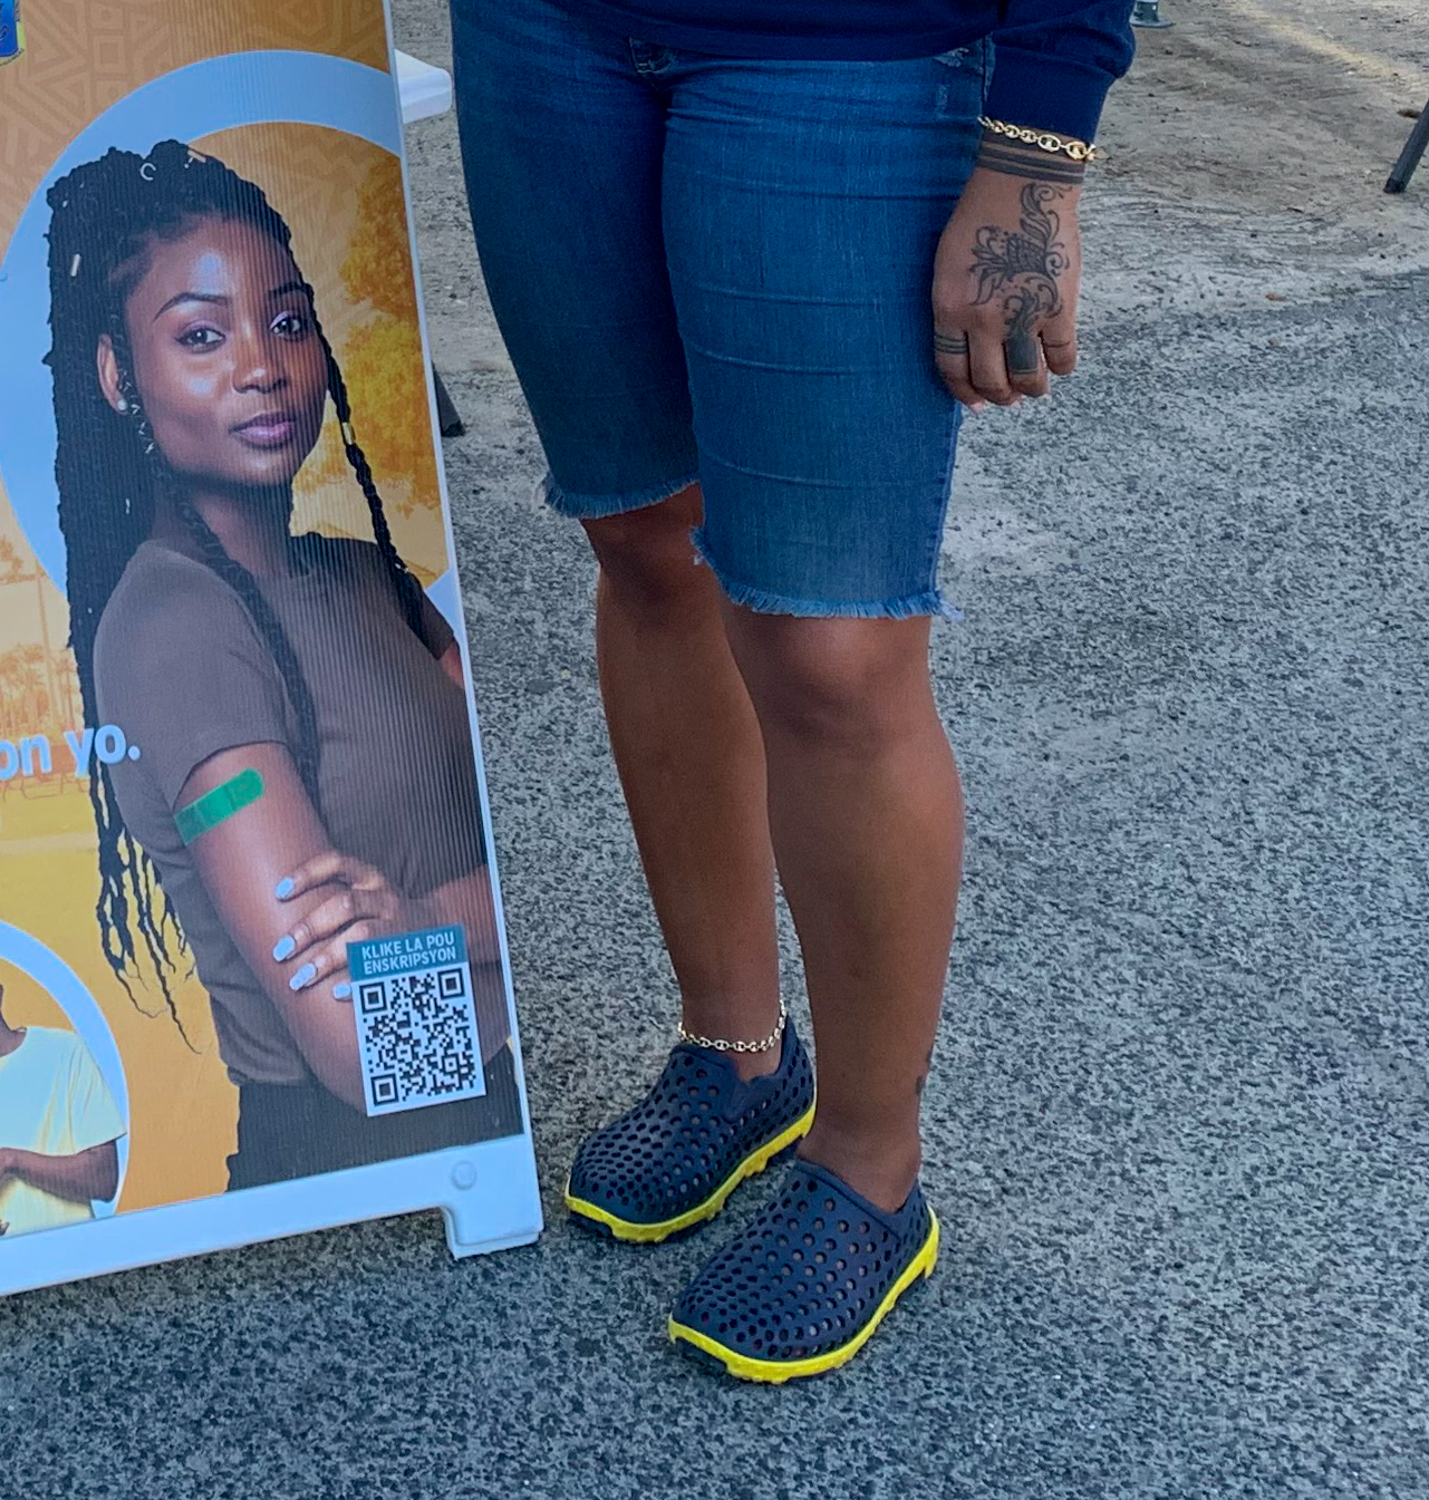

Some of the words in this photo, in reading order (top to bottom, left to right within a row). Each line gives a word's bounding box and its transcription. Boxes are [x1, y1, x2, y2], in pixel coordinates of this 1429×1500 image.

[63, 722, 141, 778] yo.
[361, 940, 402, 961] KLIKE
[405, 937, 423, 955] LA
[427, 931, 455, 946] POU
[363, 946, 457, 975] ENSKRIPSYON
